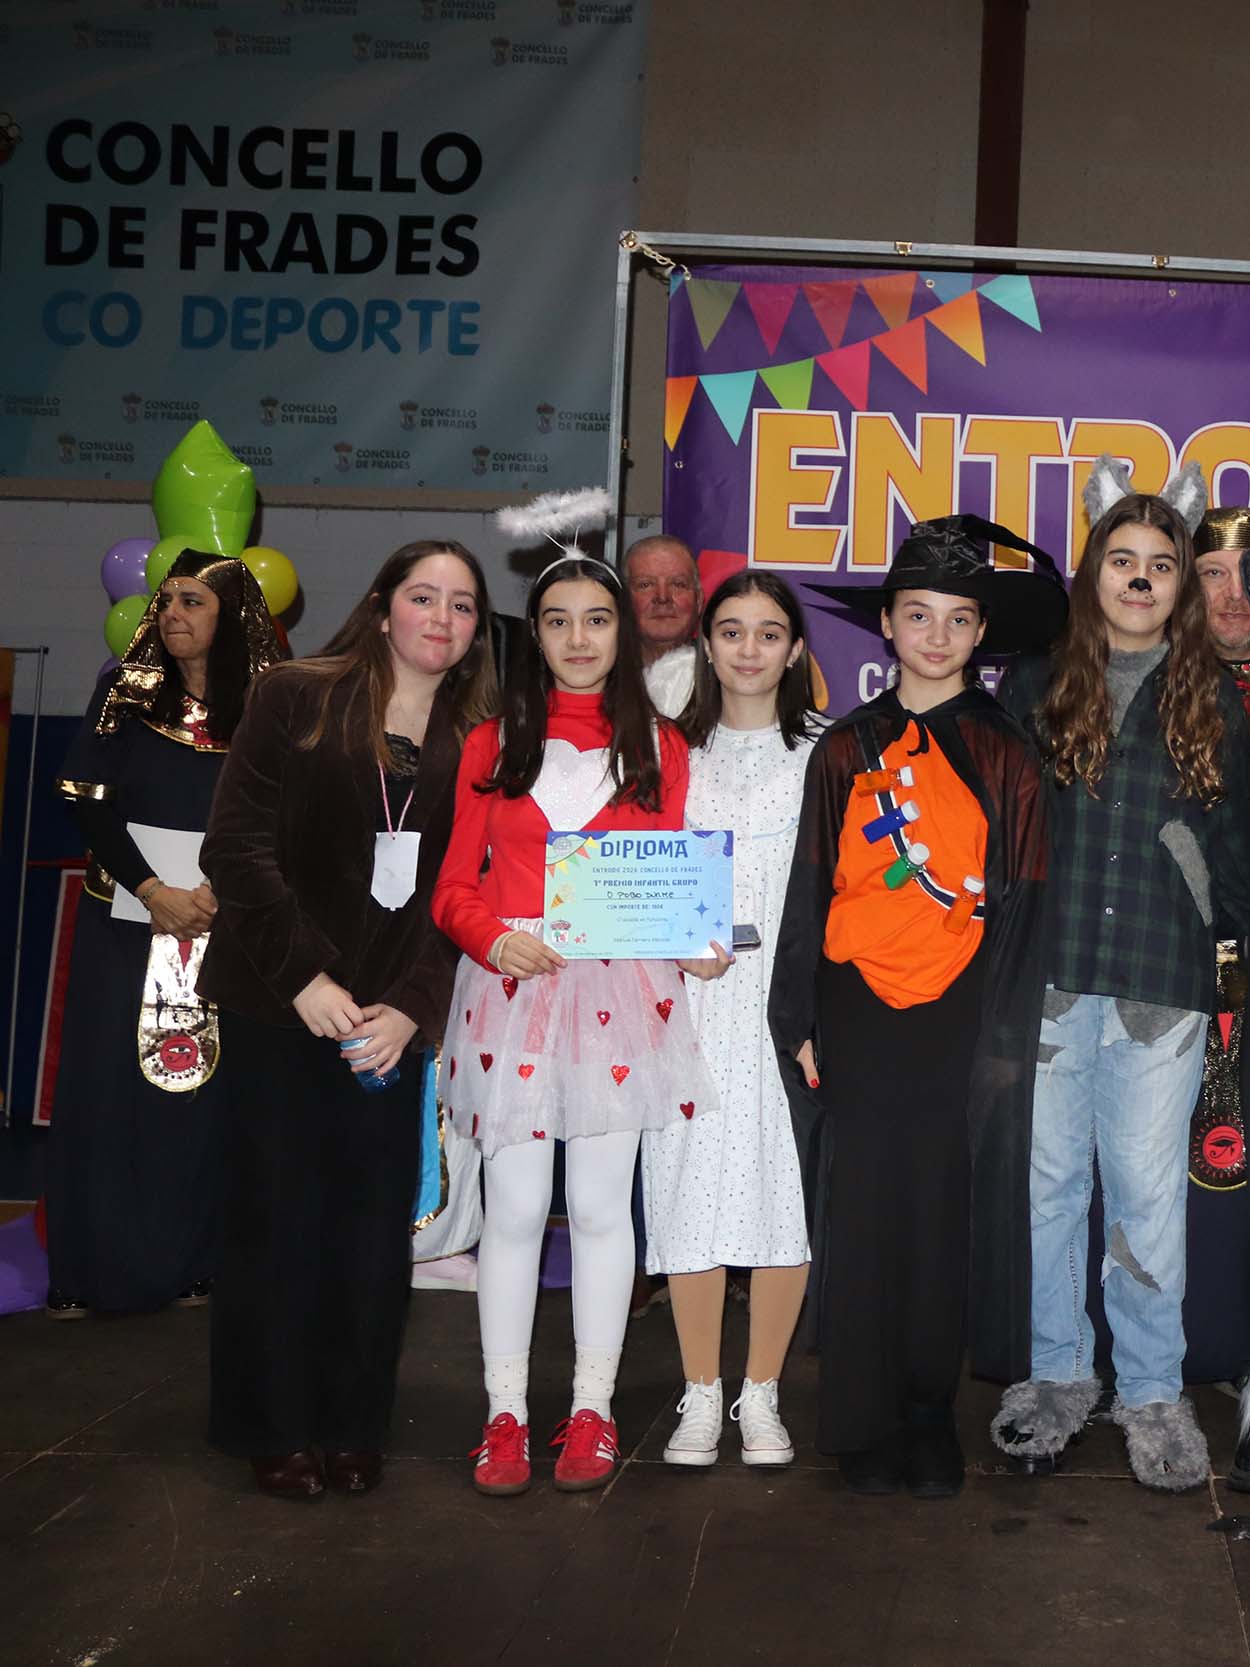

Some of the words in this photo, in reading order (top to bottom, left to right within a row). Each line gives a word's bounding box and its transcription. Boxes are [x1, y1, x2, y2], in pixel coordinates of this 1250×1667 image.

[46, 119, 482, 195] CONCELLO
[43, 204, 146, 269] DE
[179, 208, 480, 277] FRADES
[41, 290, 142, 349] CO
[180, 295, 481, 356] DEPORTE
[601, 839, 689, 860] DIPLOMA
[603, 879, 633, 887] PREMIO
[634, 879, 671, 887] INFANTIL
[672, 879, 699, 887] GRUPO
